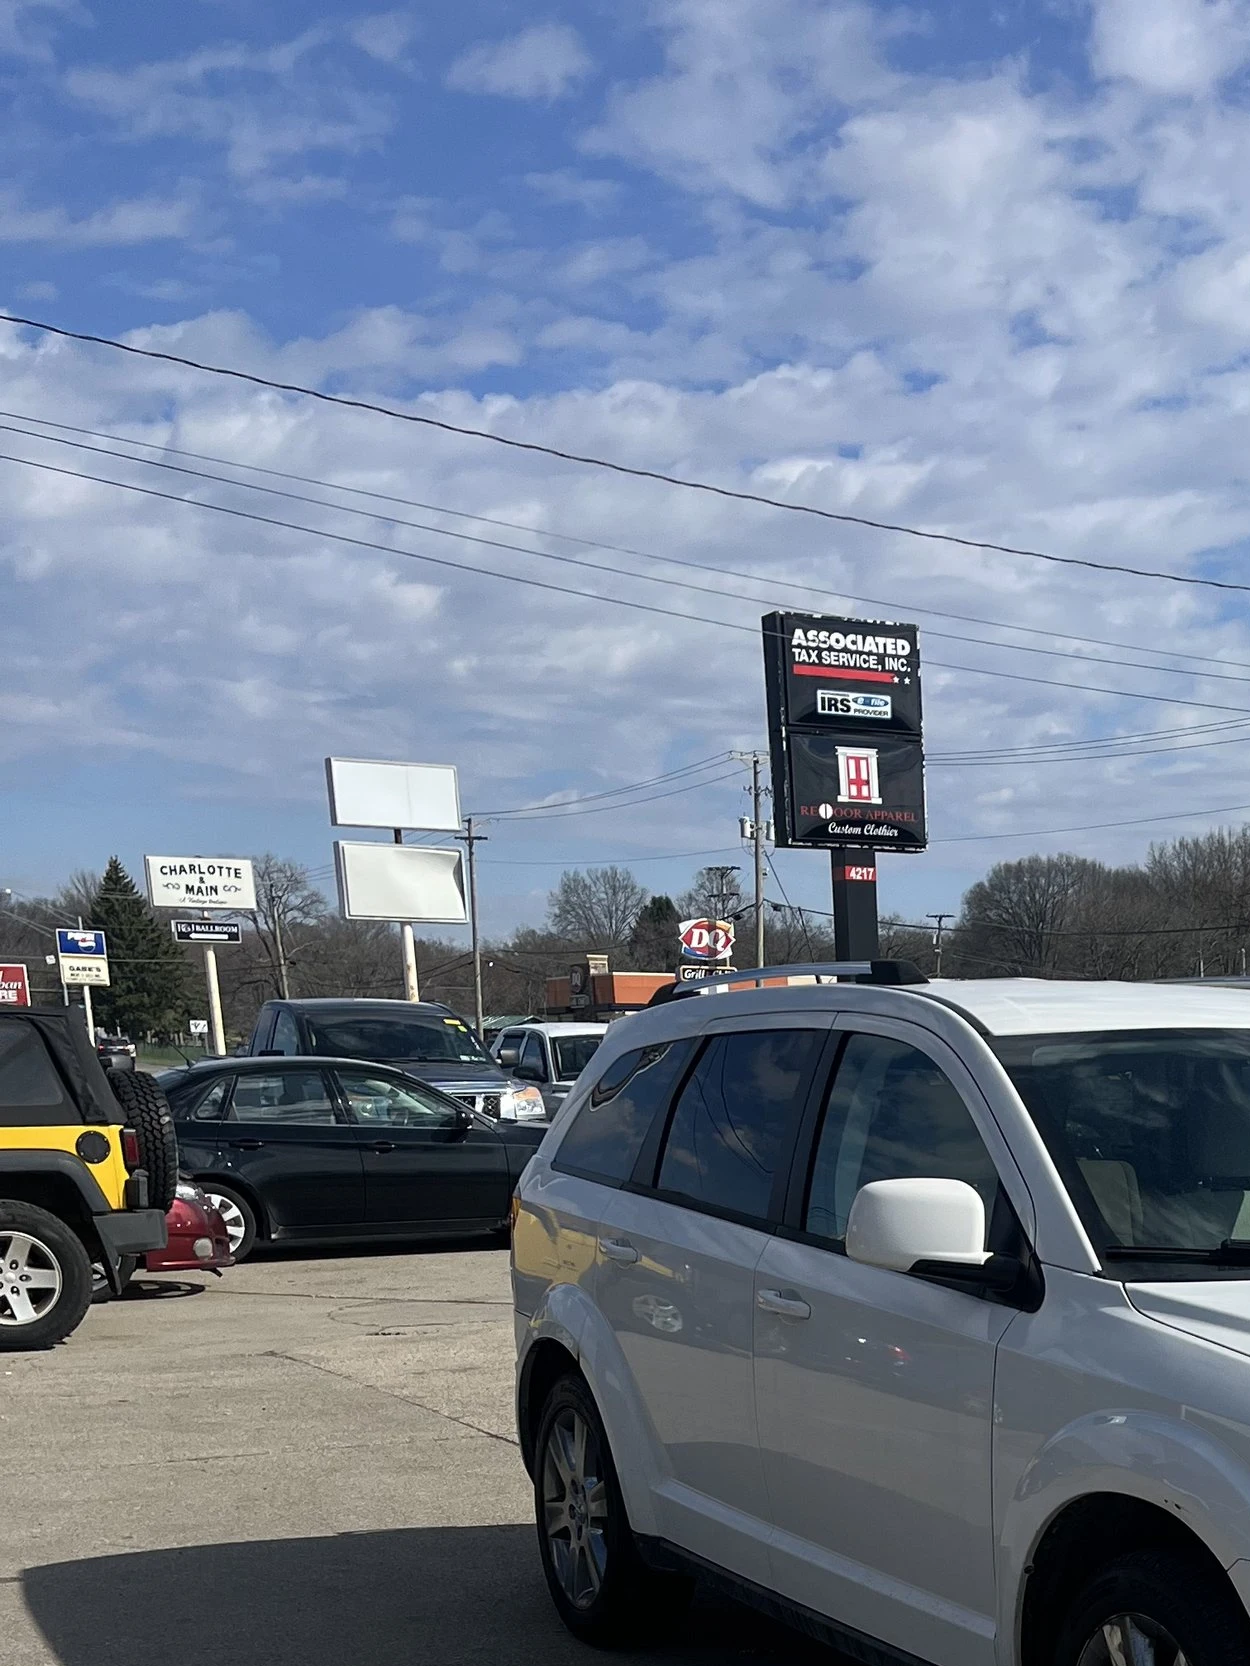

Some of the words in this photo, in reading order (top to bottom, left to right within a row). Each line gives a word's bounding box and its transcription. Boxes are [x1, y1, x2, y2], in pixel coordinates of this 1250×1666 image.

[791, 628, 911, 656] ASSOCIATED
[791, 648, 819, 663] TAX
[821, 651, 882, 672] SERVICE,
[884, 657, 911, 672] INC.
[820, 696, 852, 713] IRS
[853, 708, 889, 717] PROVIDER
[864, 809, 916, 823] APPAREL
[828, 821, 862, 836] Custom
[863, 823, 899, 837] Clothier
[160, 864, 242, 879] CHARLOTTE
[850, 867, 875, 880] 4217
[199, 876, 206, 884] &
[185, 884, 218, 896] MAIN
[195, 924, 238, 933] BALLROOM
[690, 928, 727, 951] DQ
[684, 969, 706, 979] Grill
